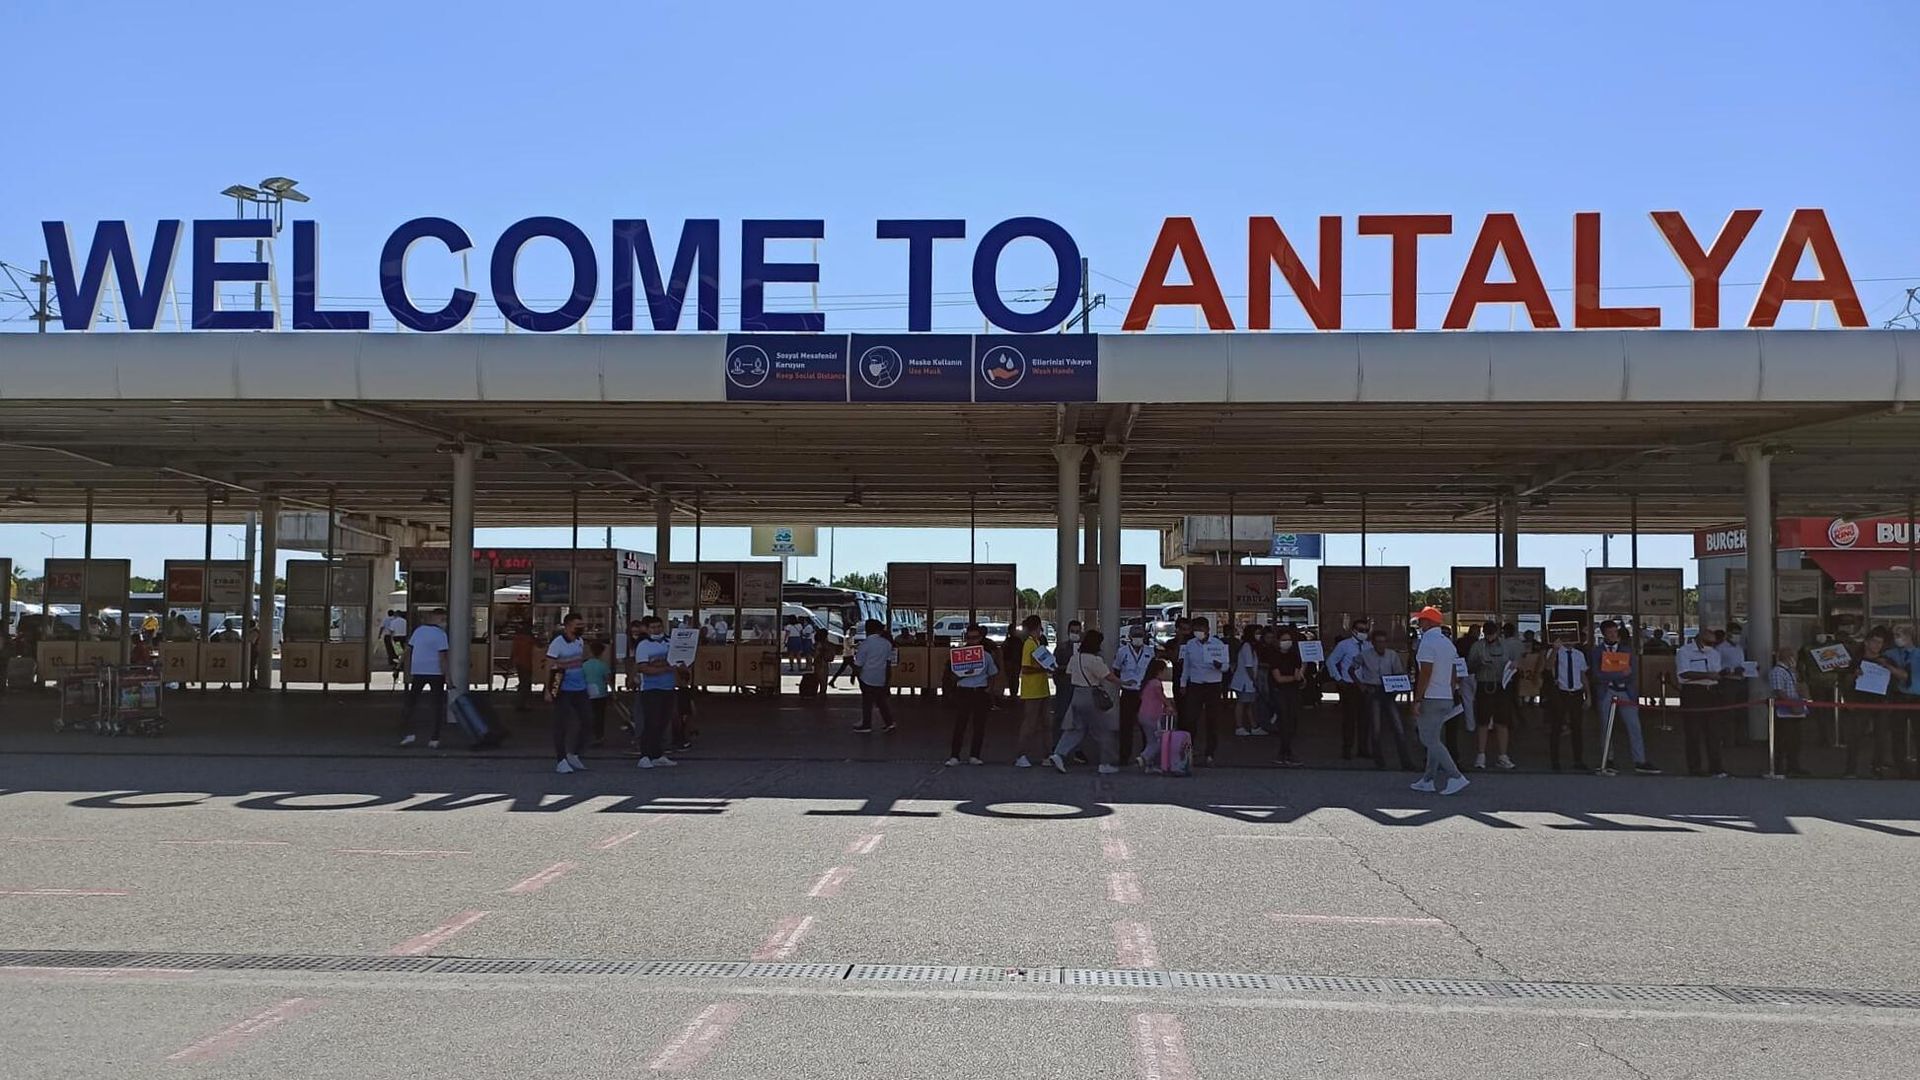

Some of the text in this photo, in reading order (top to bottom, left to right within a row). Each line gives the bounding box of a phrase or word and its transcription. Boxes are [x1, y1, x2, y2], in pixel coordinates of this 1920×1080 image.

[41, 210, 1868, 333] WELCOME TO ANTALYA
[776, 352, 837, 361] Sosyal Mesafenizi
[776, 362, 805, 370] Koruyun
[1706, 530, 1747, 551] BURGER
[171, 657, 184, 668] 21
[212, 657, 225, 668] 22
[293, 657, 307, 668] 23
[334, 657, 349, 668] 24
[706, 660, 721, 671] 30
[901, 662, 915, 673] 32
